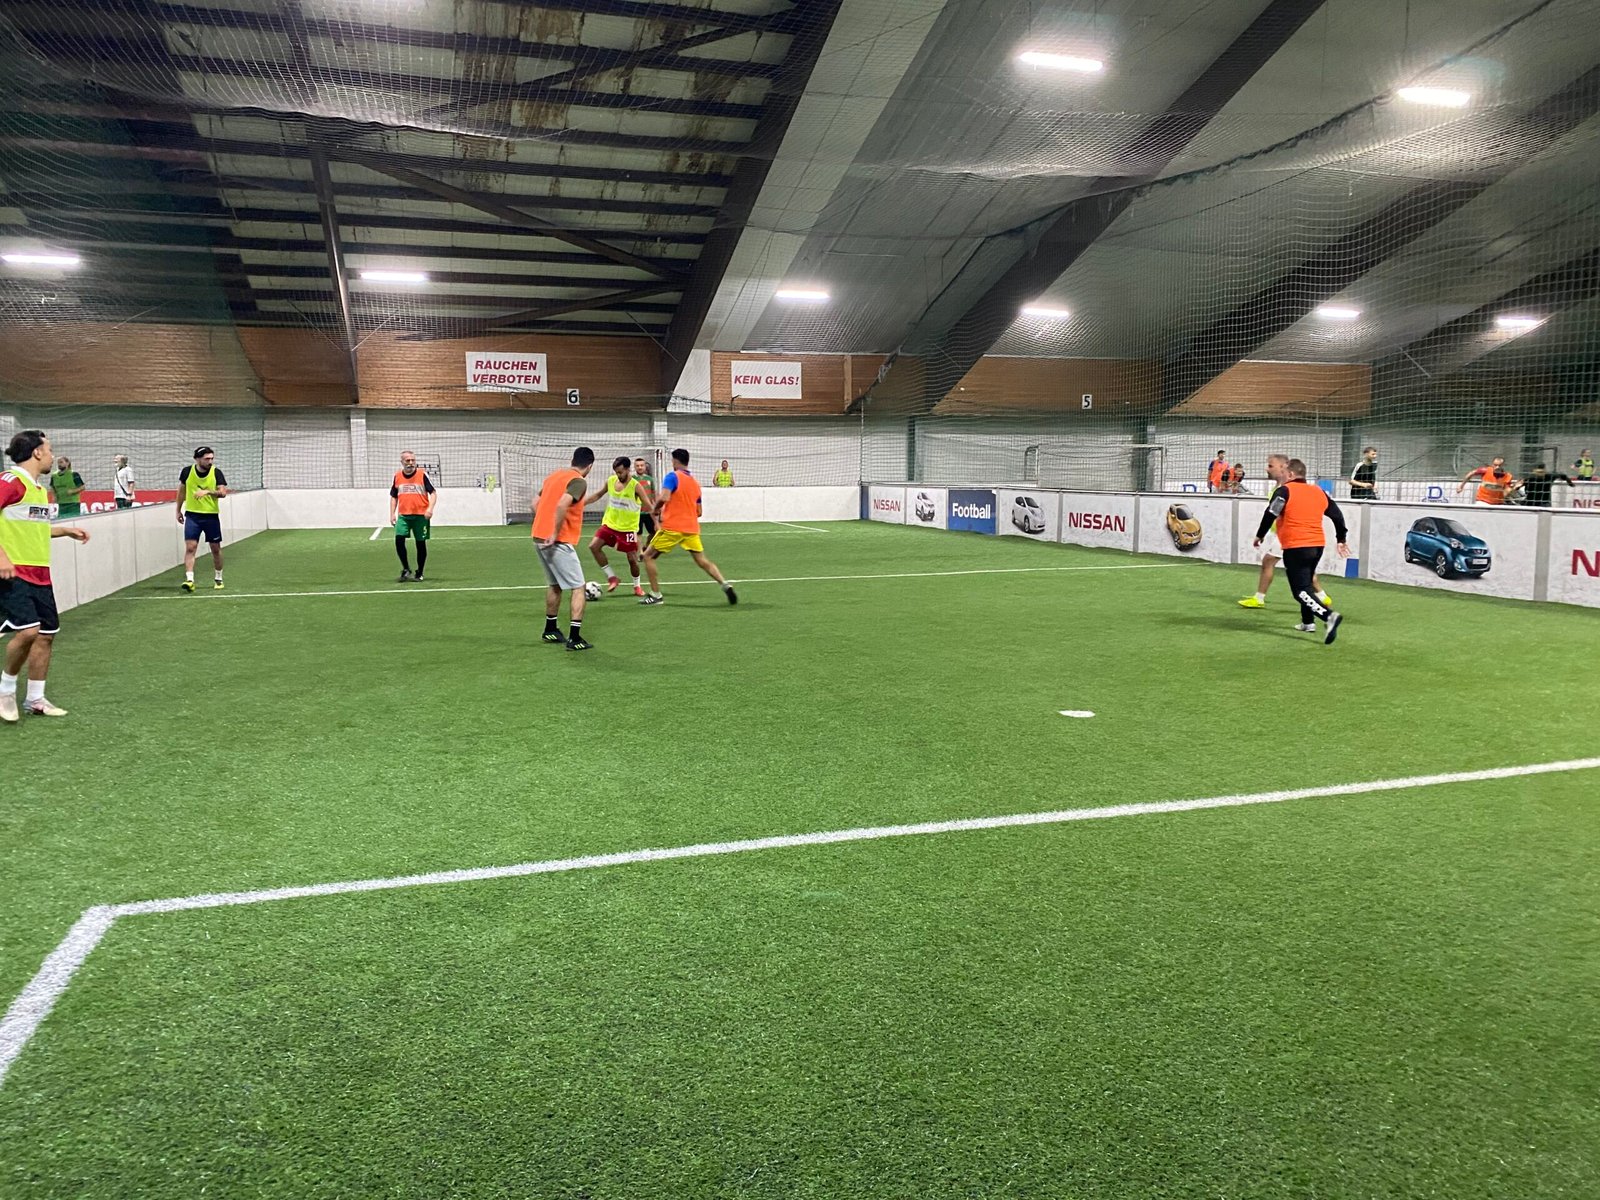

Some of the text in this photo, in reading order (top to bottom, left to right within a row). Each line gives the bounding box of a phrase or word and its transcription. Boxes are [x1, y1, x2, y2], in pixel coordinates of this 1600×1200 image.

[474, 360, 538, 370] RAUCHEN
[472, 374, 541, 384] VERBOTEN
[734, 375, 800, 385] KEIN GLAS!
[568, 390, 578, 404] 6
[1084, 395, 1090, 408] 5
[873, 499, 901, 512] NISSAN
[952, 502, 991, 519] Football
[1068, 512, 1126, 532] NISSAN
